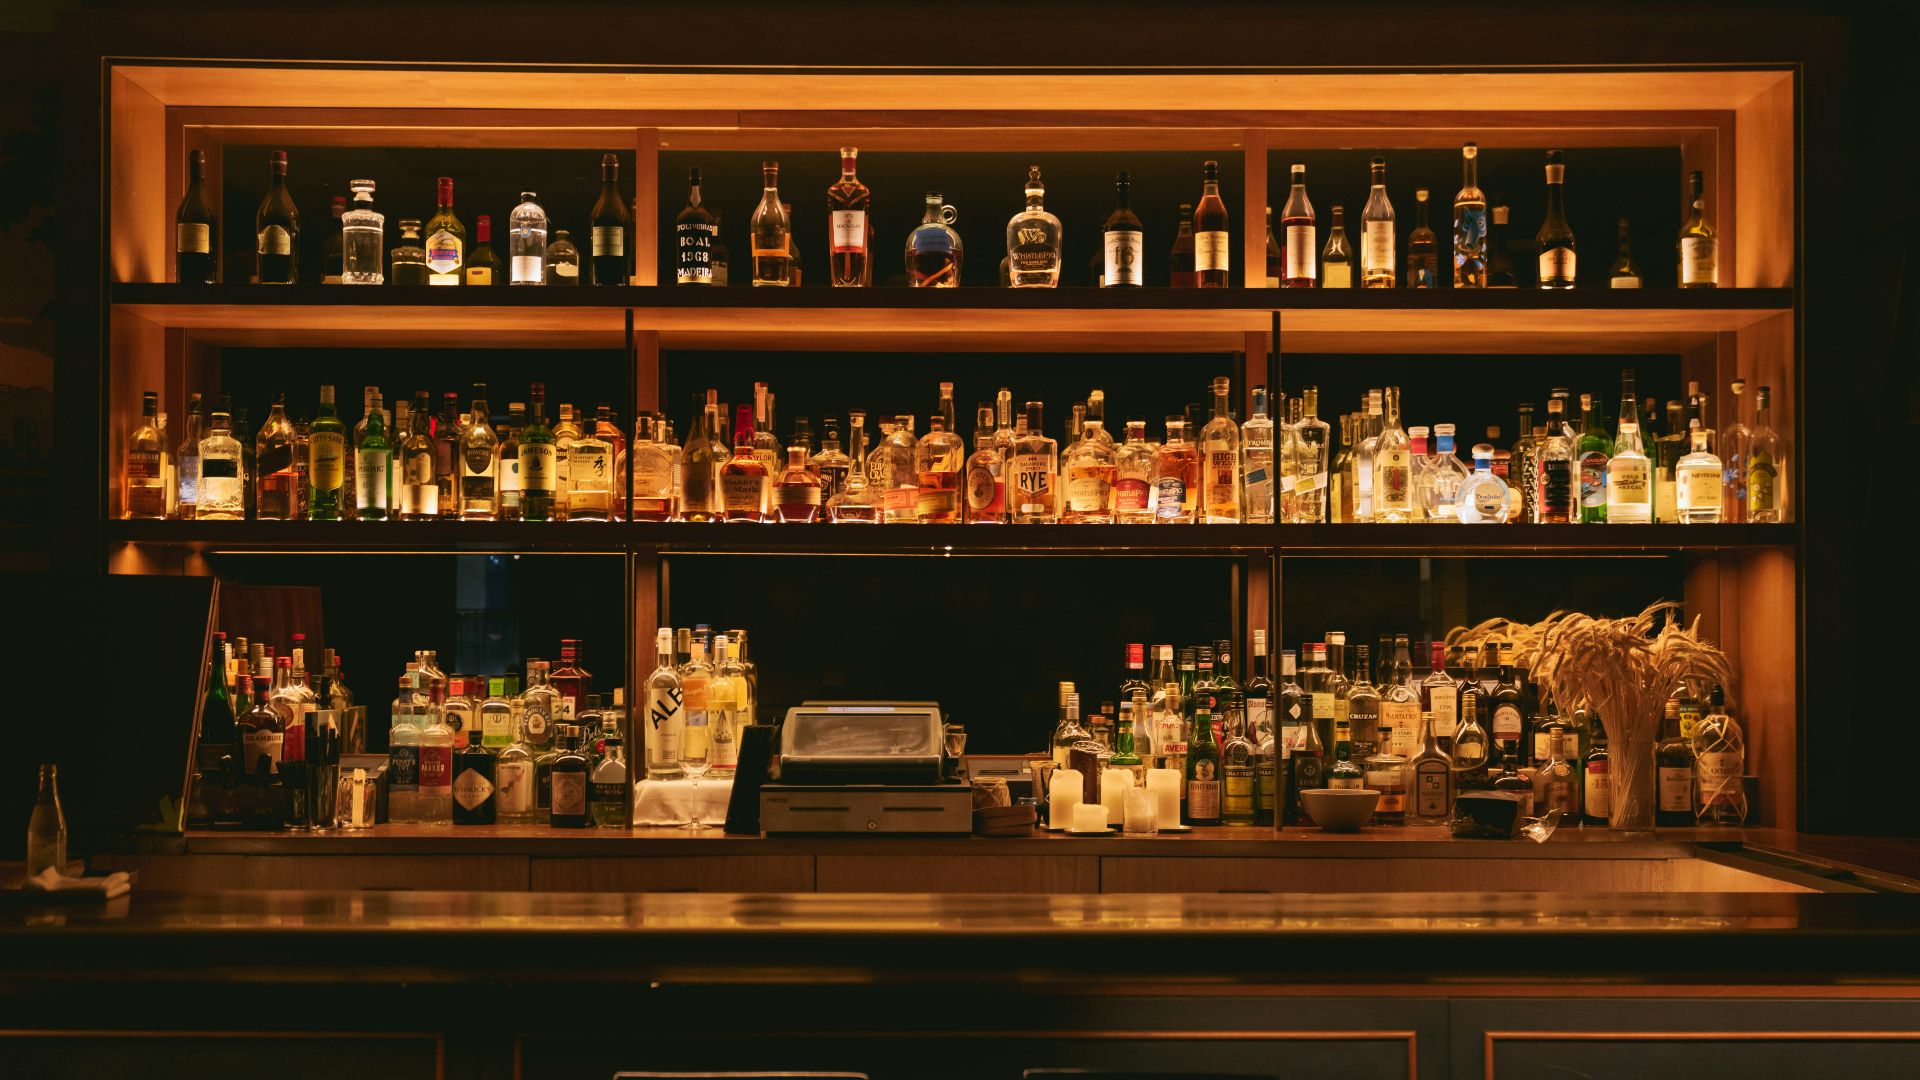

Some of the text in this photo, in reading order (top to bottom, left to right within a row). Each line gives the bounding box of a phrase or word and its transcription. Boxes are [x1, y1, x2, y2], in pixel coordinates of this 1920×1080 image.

[680, 236, 711, 247] BOAL
[681, 251, 709, 263] 1968
[677, 266, 713, 277] MADEIRA
[521, 447, 552, 457] JAMESON
[1020, 471, 1047, 492] RYE
[421, 764, 445, 772] PARKER
